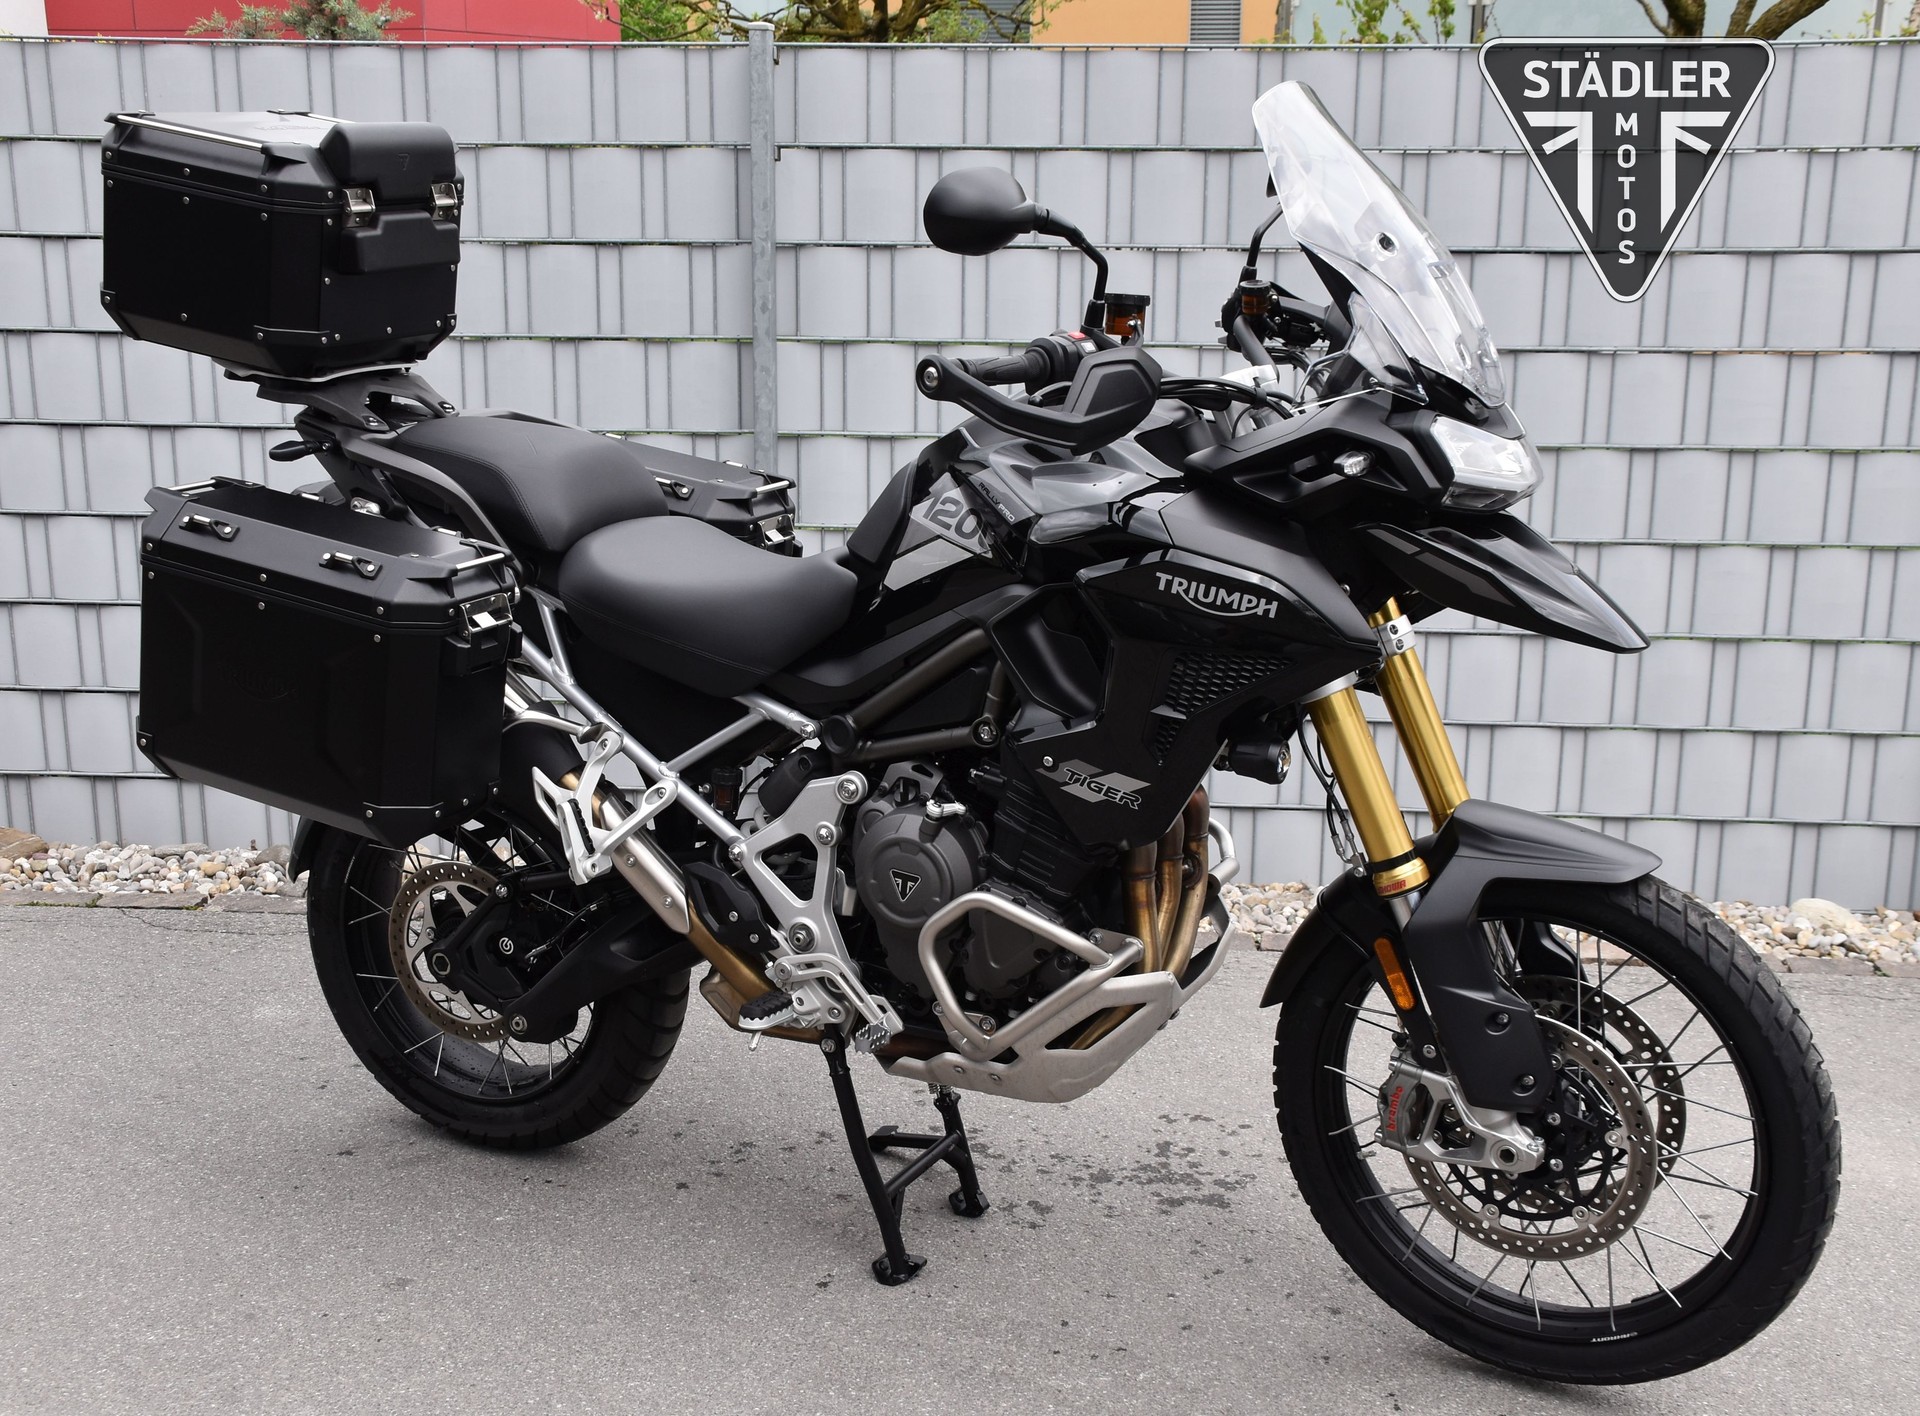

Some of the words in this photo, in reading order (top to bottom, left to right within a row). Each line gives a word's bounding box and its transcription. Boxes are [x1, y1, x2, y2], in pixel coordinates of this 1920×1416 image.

[1155, 572, 1279, 619] TRIUMPH
[1063, 767, 1142, 810] TIGER
[1386, 1086, 1404, 1132] brembo
